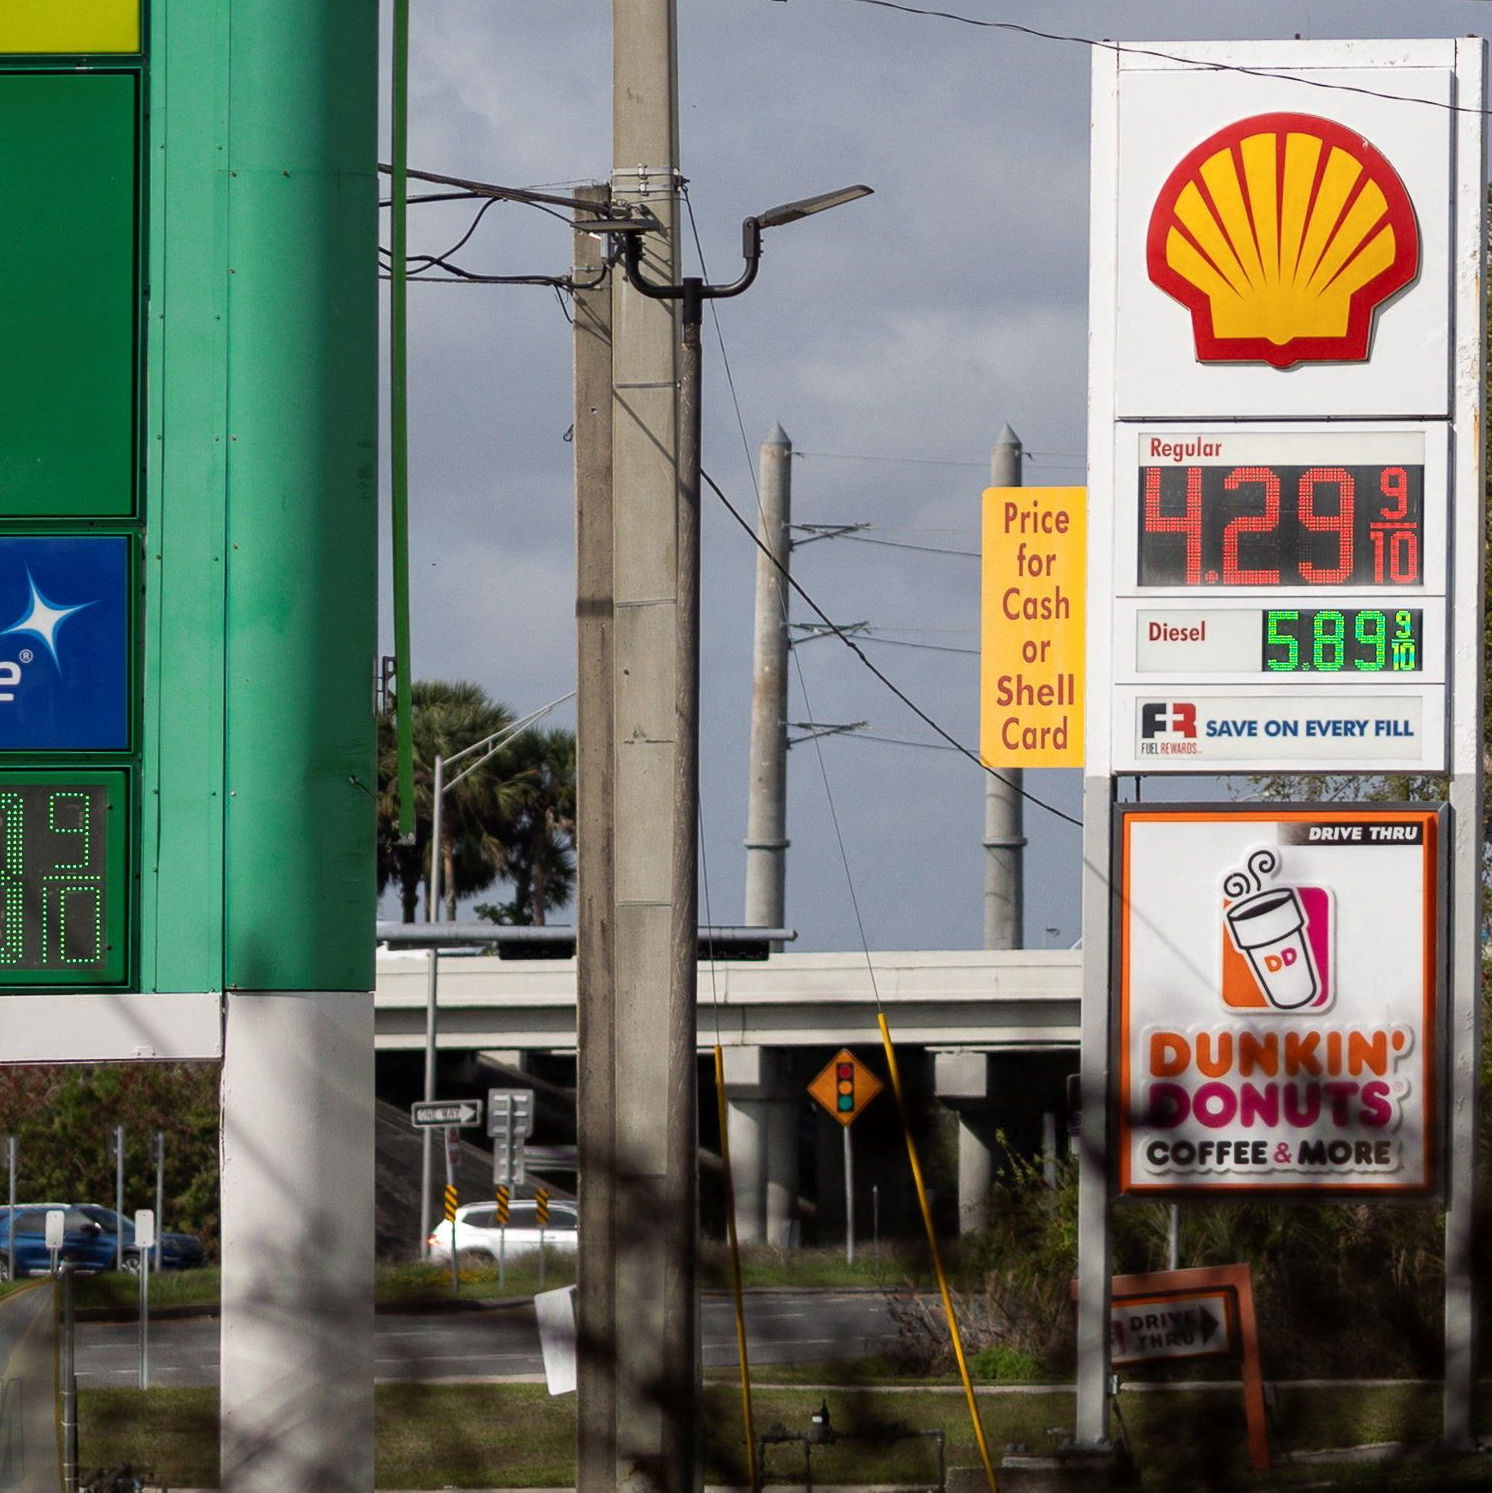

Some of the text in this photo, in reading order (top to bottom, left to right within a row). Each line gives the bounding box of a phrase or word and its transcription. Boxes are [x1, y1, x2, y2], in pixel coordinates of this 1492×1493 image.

[1149, 436, 1223, 461] Regular
[1004, 500, 1070, 534] Price
[1143, 467, 1355, 585] 4.29
[1017, 542, 1057, 577] for
[1002, 586, 1070, 621] Cash
[1148, 619, 1207, 643] Diesel
[1267, 610, 1386, 671] 5.89
[1022, 639, 1051, 664] or
[996, 673, 1075, 707] Shell
[1001, 715, 1069, 751] Card
[1205, 719, 1415, 737] SAVE ON EVERY FILL
[1141, 742, 1198, 755] FUEL REWARDS
[1308, 825, 1418, 841] DRIVE THRU
[1264, 947, 1298, 973] DD
[1149, 1030, 1405, 1078] DUNKIN'
[1146, 1139, 1392, 1166] COFFEE & MORE
[1137, 1329, 1195, 1350] THRU
